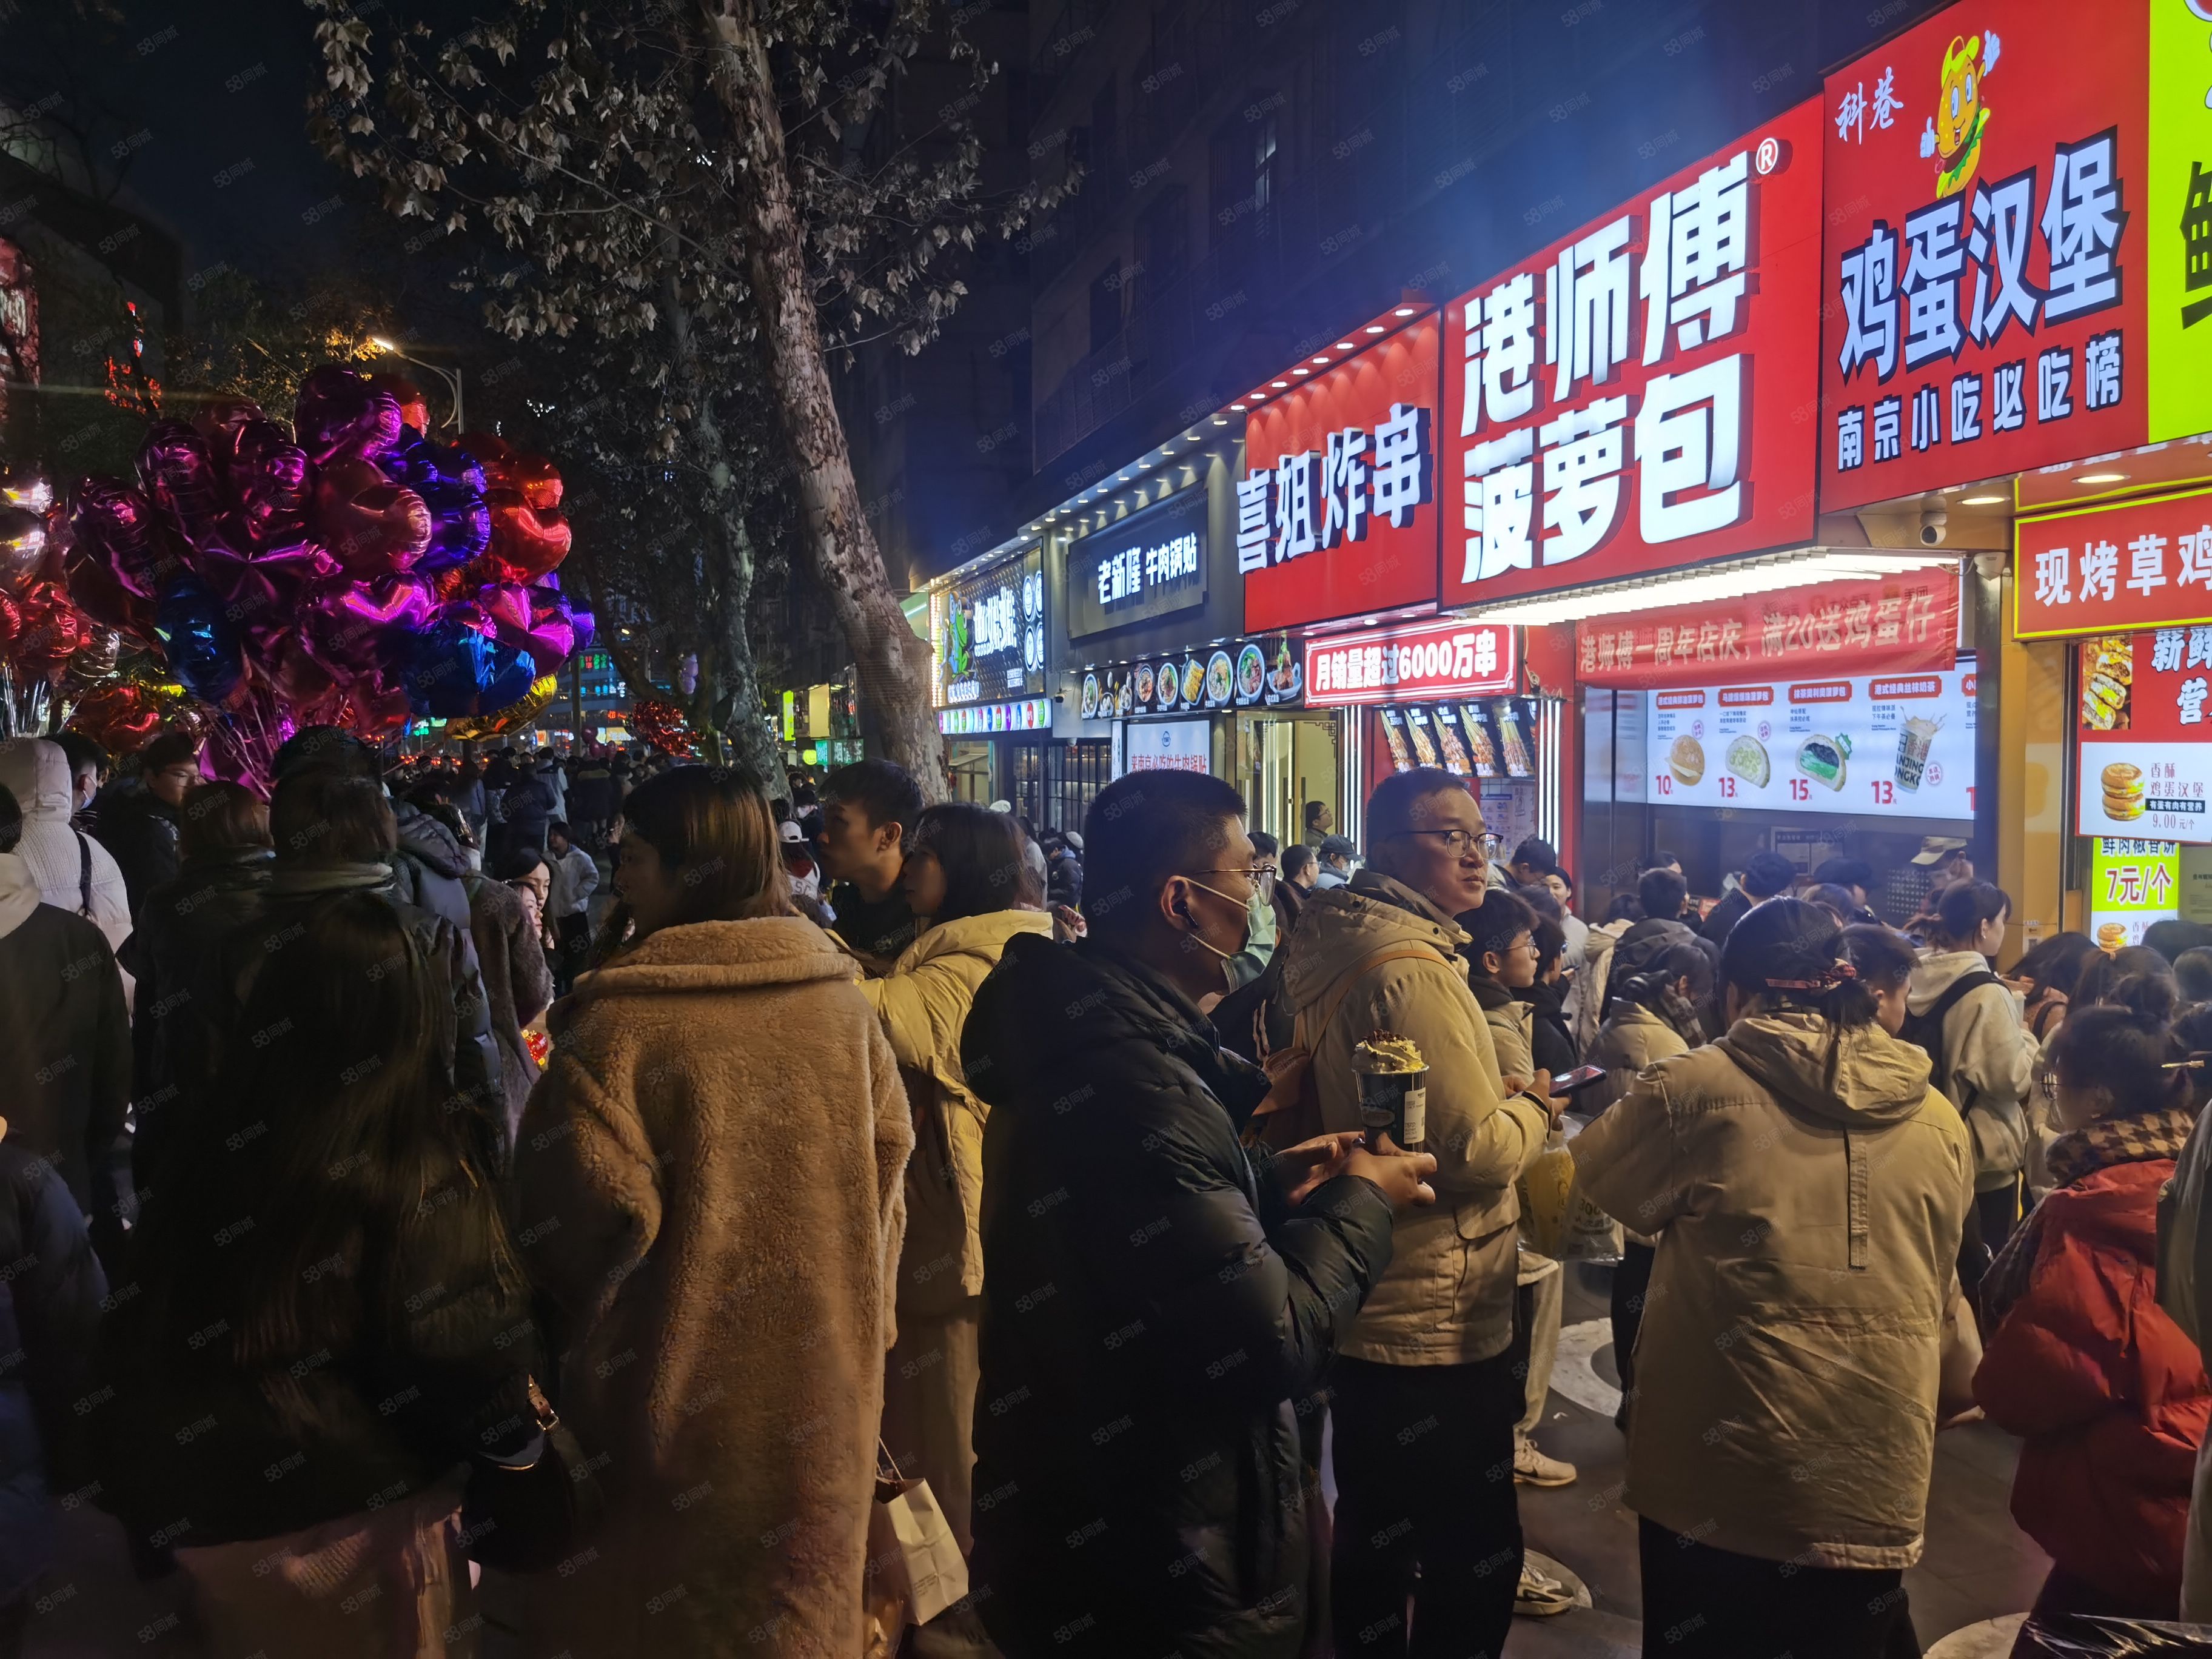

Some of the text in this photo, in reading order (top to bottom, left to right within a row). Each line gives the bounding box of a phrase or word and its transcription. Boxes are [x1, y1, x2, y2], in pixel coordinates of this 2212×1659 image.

[1838, 135, 2121, 381] 鸡蛋汉堡
[1460, 150, 1750, 437] 港师傅
[1838, 333, 2122, 472] 南京小吃必吃榜
[1237, 403, 1420, 575] 喜姐炸串
[1461, 354, 1740, 584] 菠萝包
[1146, 532, 1196, 586] 牛肉锅贴
[1316, 629, 1496, 691] 月销量超过6000万串
[2150, 781, 2204, 799] 鸡蛋汉堡
[2151, 762, 2176, 779] 香酥
[2150, 800, 2203, 813] 有蛋有肉有营养
[2153, 814, 2176, 829] 9.00
[2106, 865, 2173, 905] 7元/个
